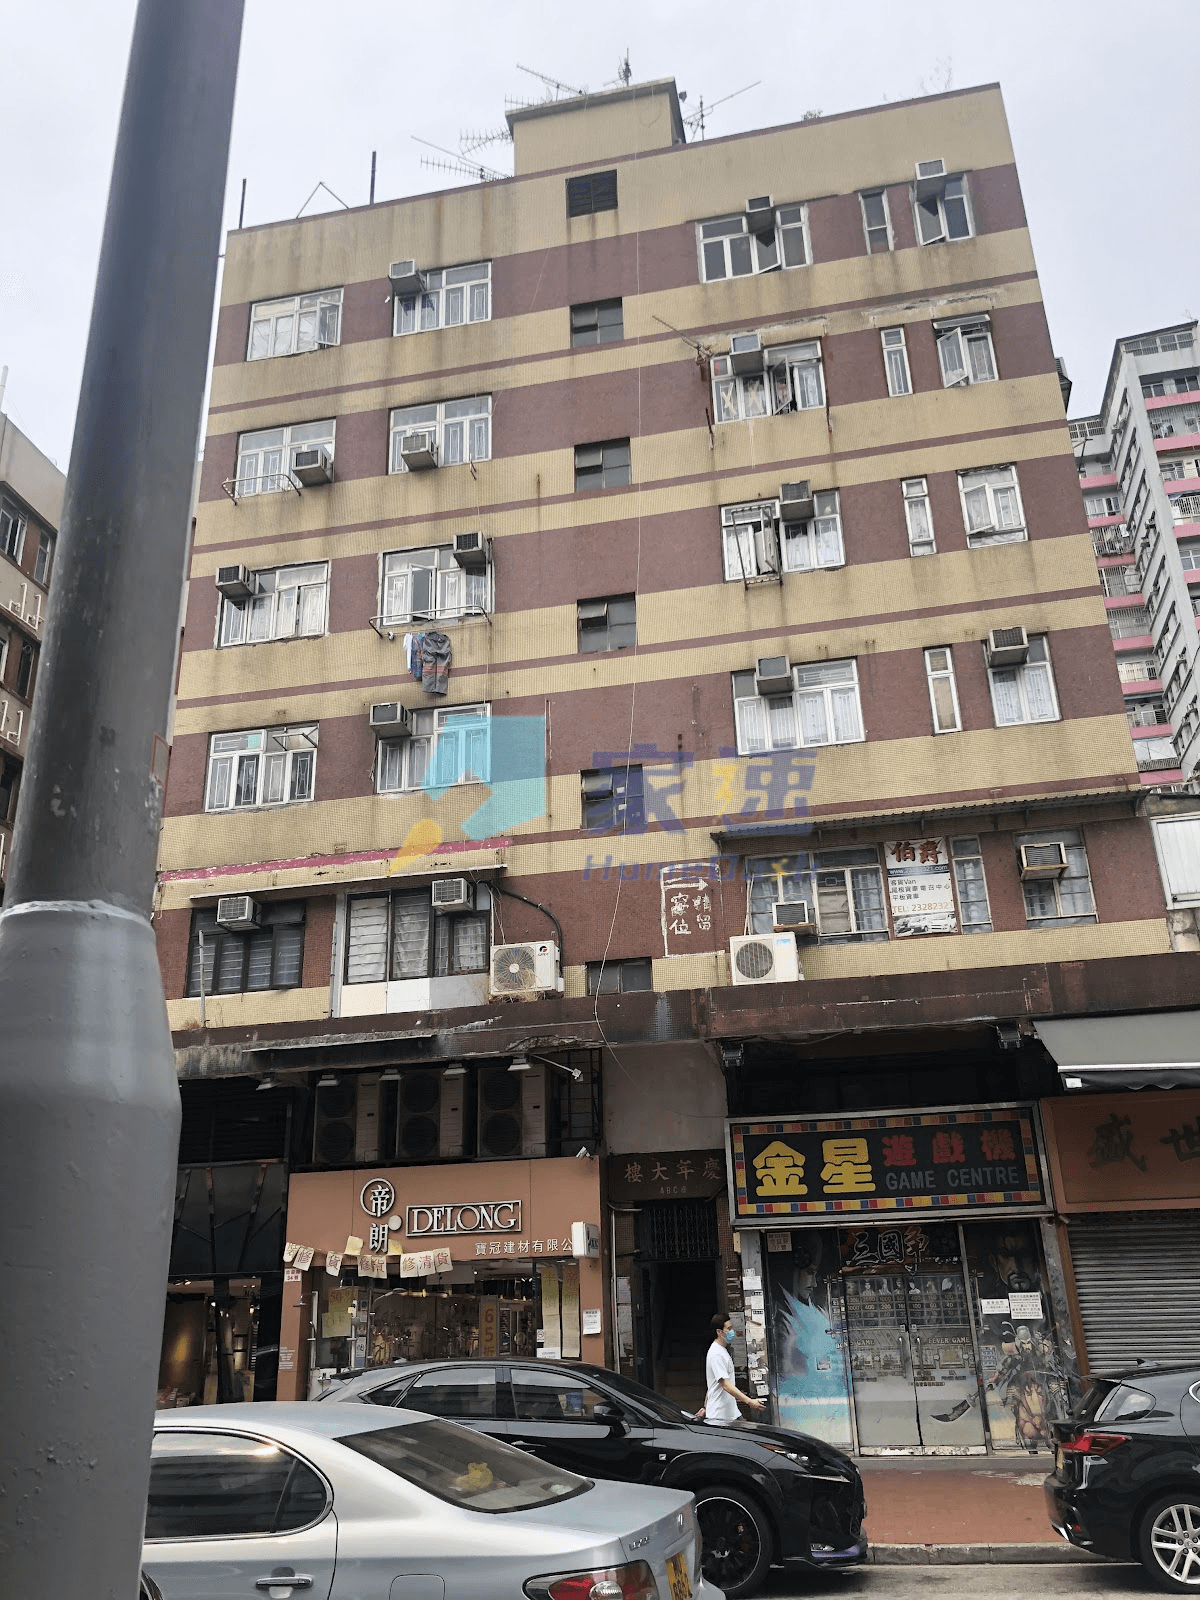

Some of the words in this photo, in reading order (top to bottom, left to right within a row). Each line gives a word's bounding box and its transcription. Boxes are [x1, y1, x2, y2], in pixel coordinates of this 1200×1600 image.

[890, 841, 942, 864] 伯爵
[752, 1138, 876, 1197] 金星
[886, 1170, 936, 1190] GAME
[946, 1166, 1019, 1187] CENTRE
[411, 1203, 517, 1233] DELONG
